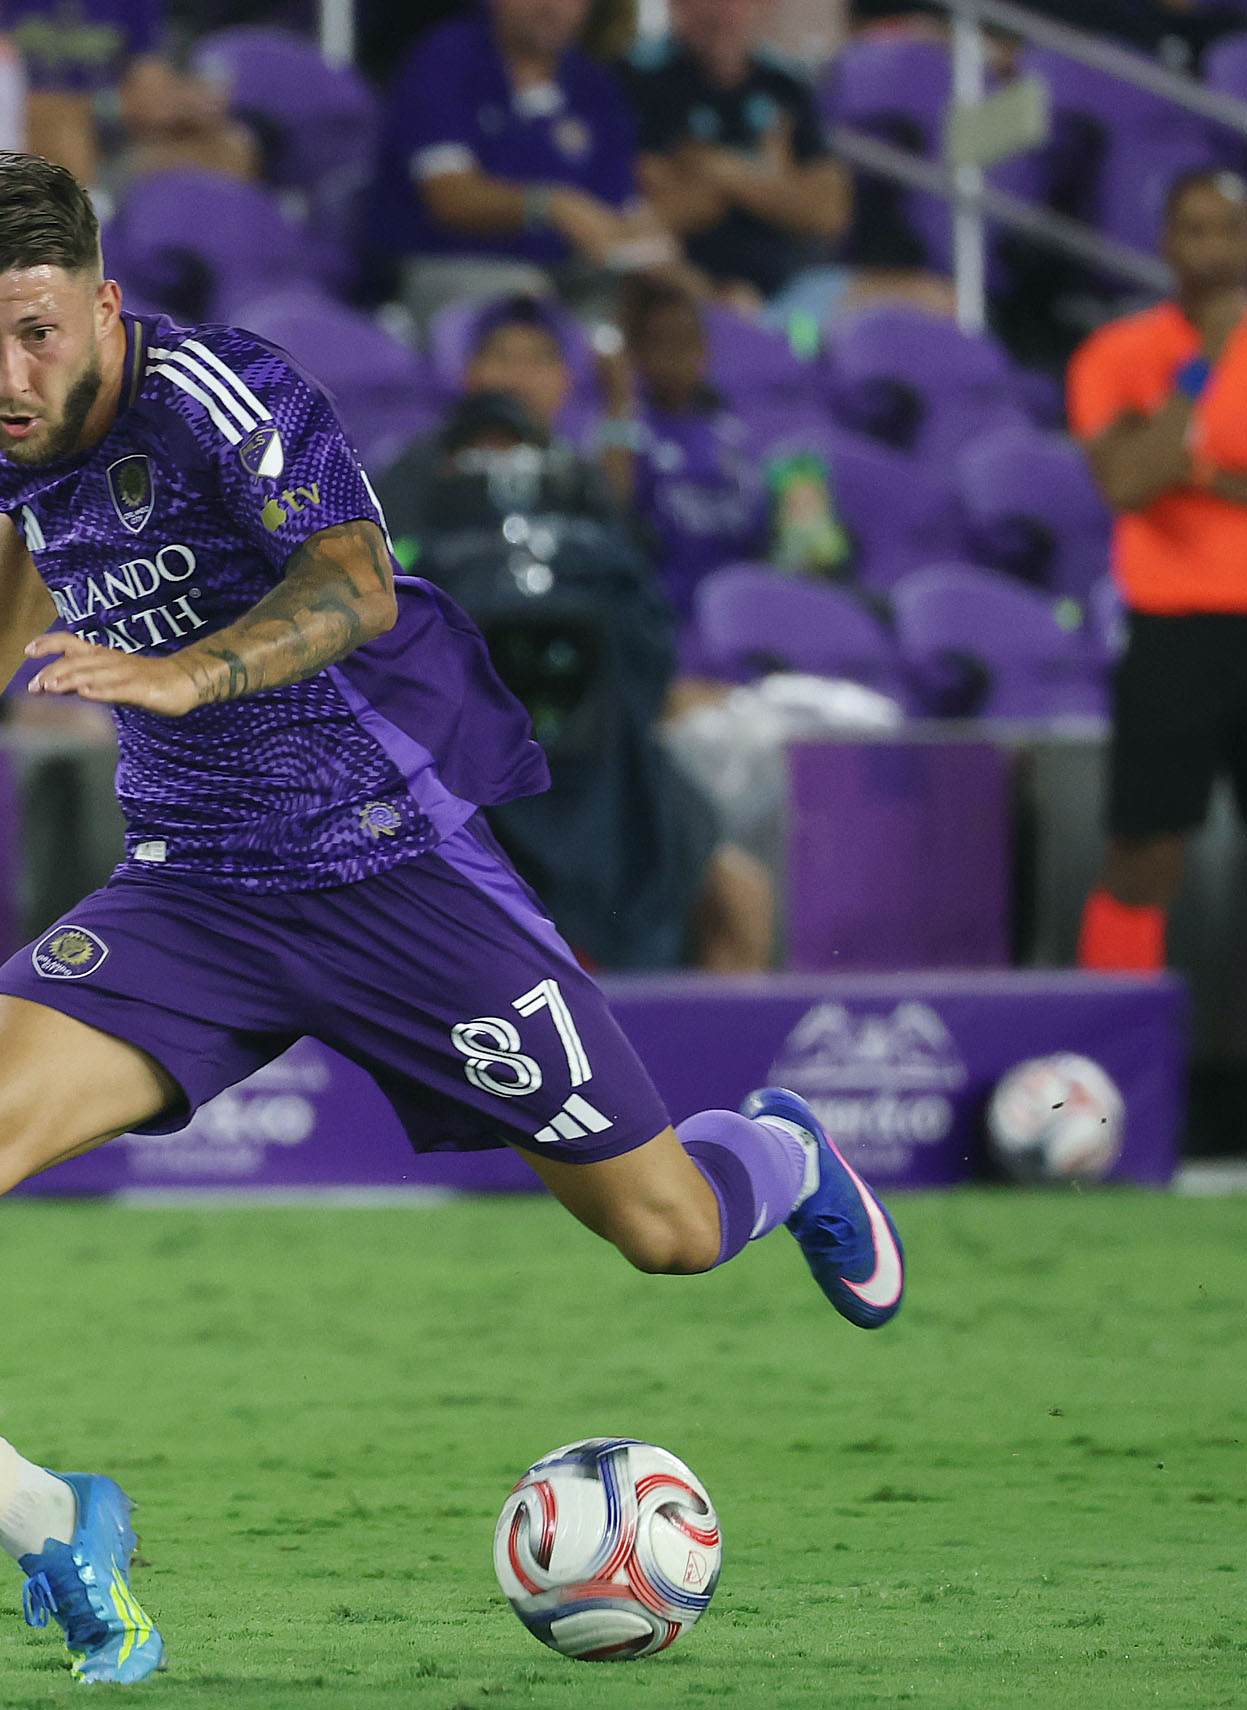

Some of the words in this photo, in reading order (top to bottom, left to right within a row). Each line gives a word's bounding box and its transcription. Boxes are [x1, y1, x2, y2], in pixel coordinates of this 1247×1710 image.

[282, 483, 321, 512] tv
[49, 544, 197, 624] RLANDO
[75, 595, 209, 654] ALTH
[451, 979, 592, 1099] 87
